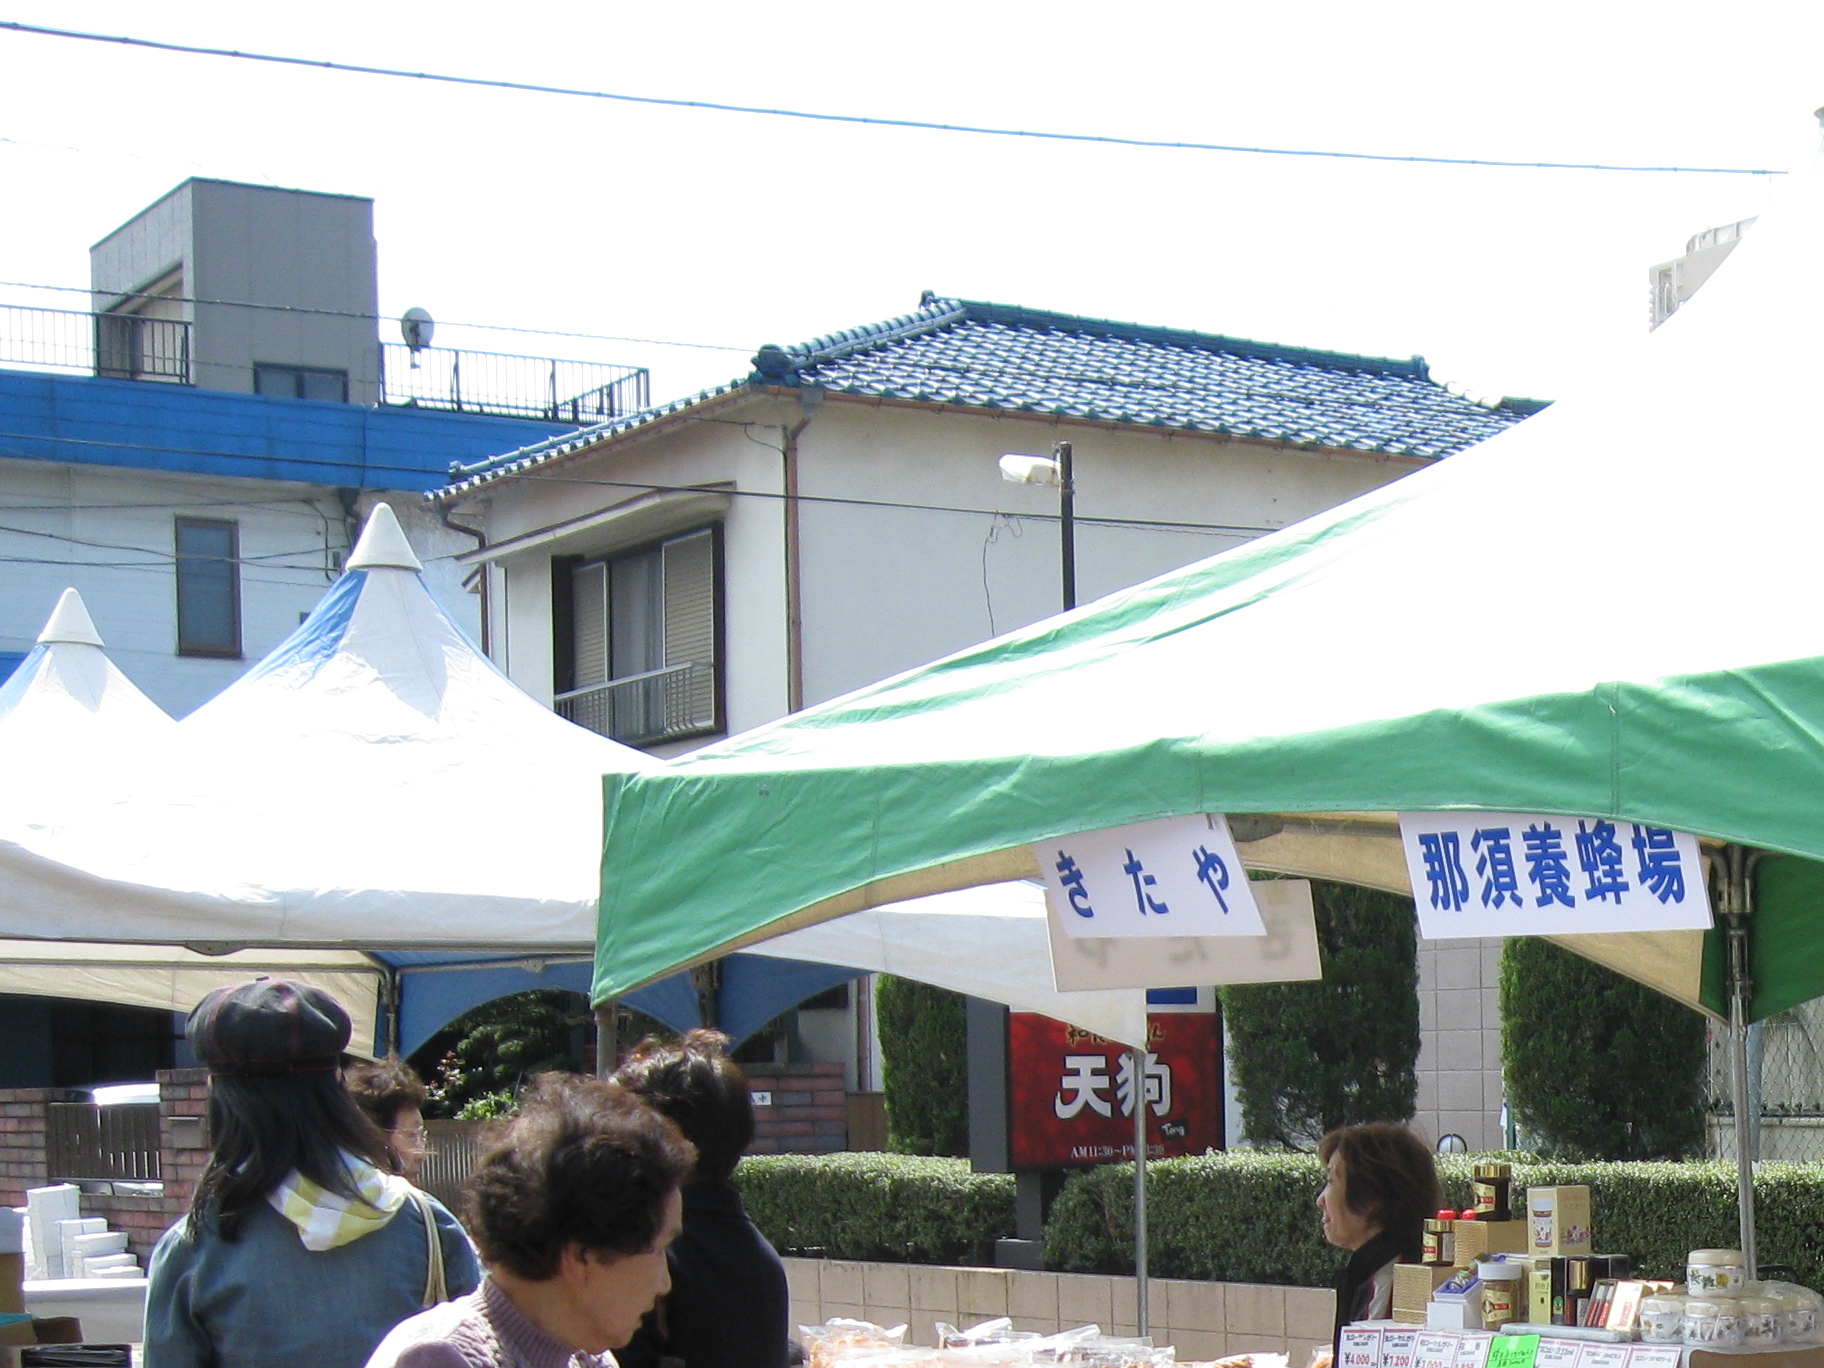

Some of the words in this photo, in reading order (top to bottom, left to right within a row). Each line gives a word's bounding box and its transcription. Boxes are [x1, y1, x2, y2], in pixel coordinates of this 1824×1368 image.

[1056, 844, 1230, 918] きたや
[1417, 818, 1686, 912] 那須養蜂場
[1054, 1053, 1171, 1119] 天狗
